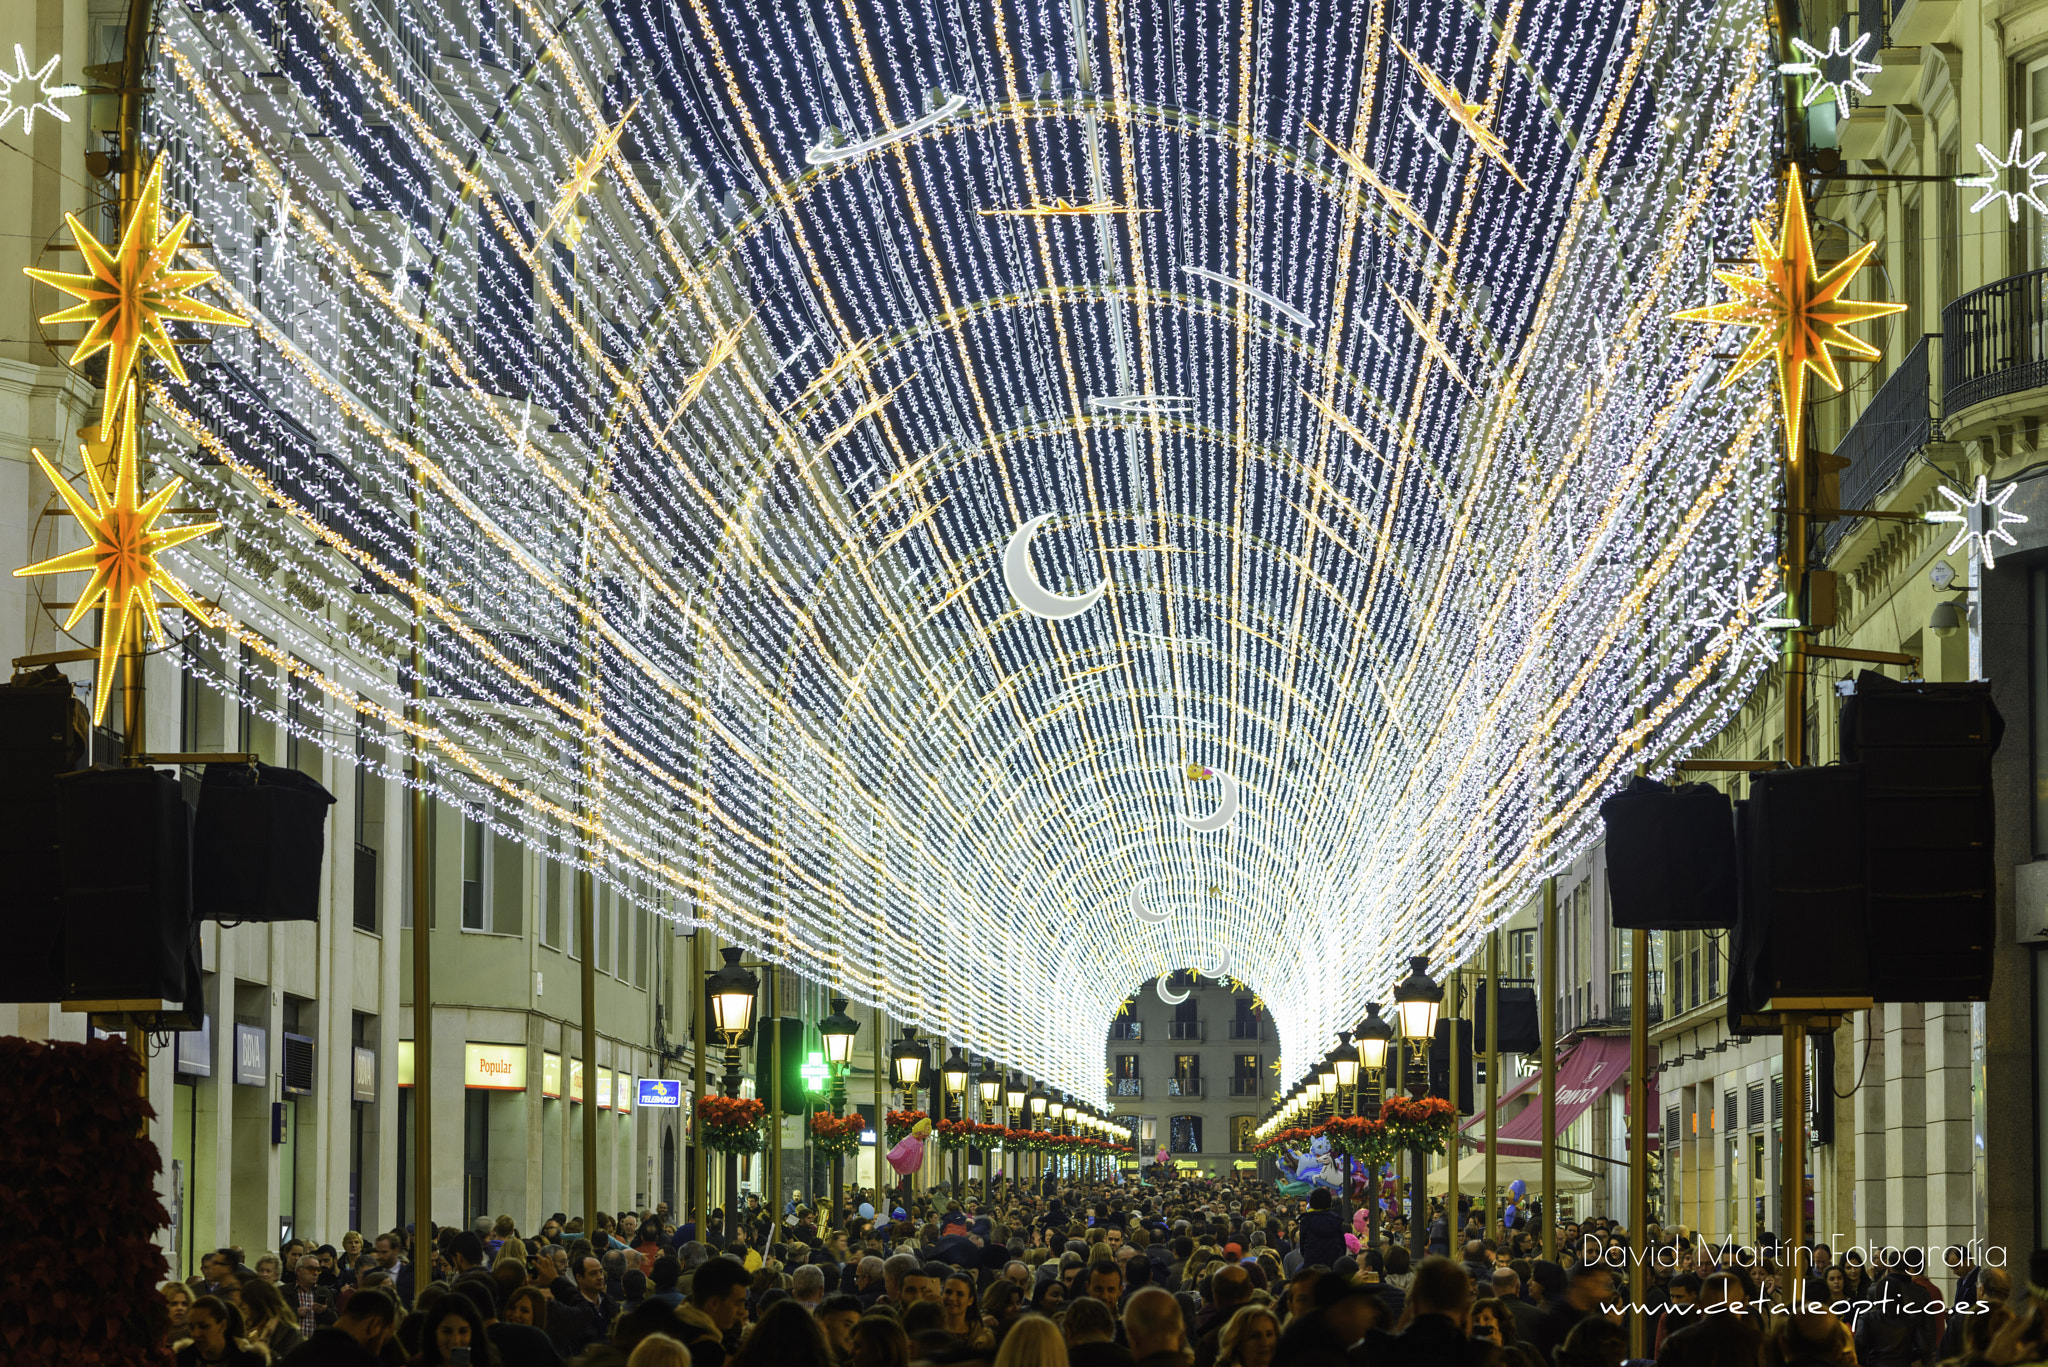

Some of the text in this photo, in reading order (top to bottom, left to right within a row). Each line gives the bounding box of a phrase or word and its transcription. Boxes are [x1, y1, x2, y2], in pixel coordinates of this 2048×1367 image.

[242, 1033, 261, 1068] BBVA
[480, 1058, 512, 1076] Popular
[641, 1095, 677, 1104] TELEBANCO
